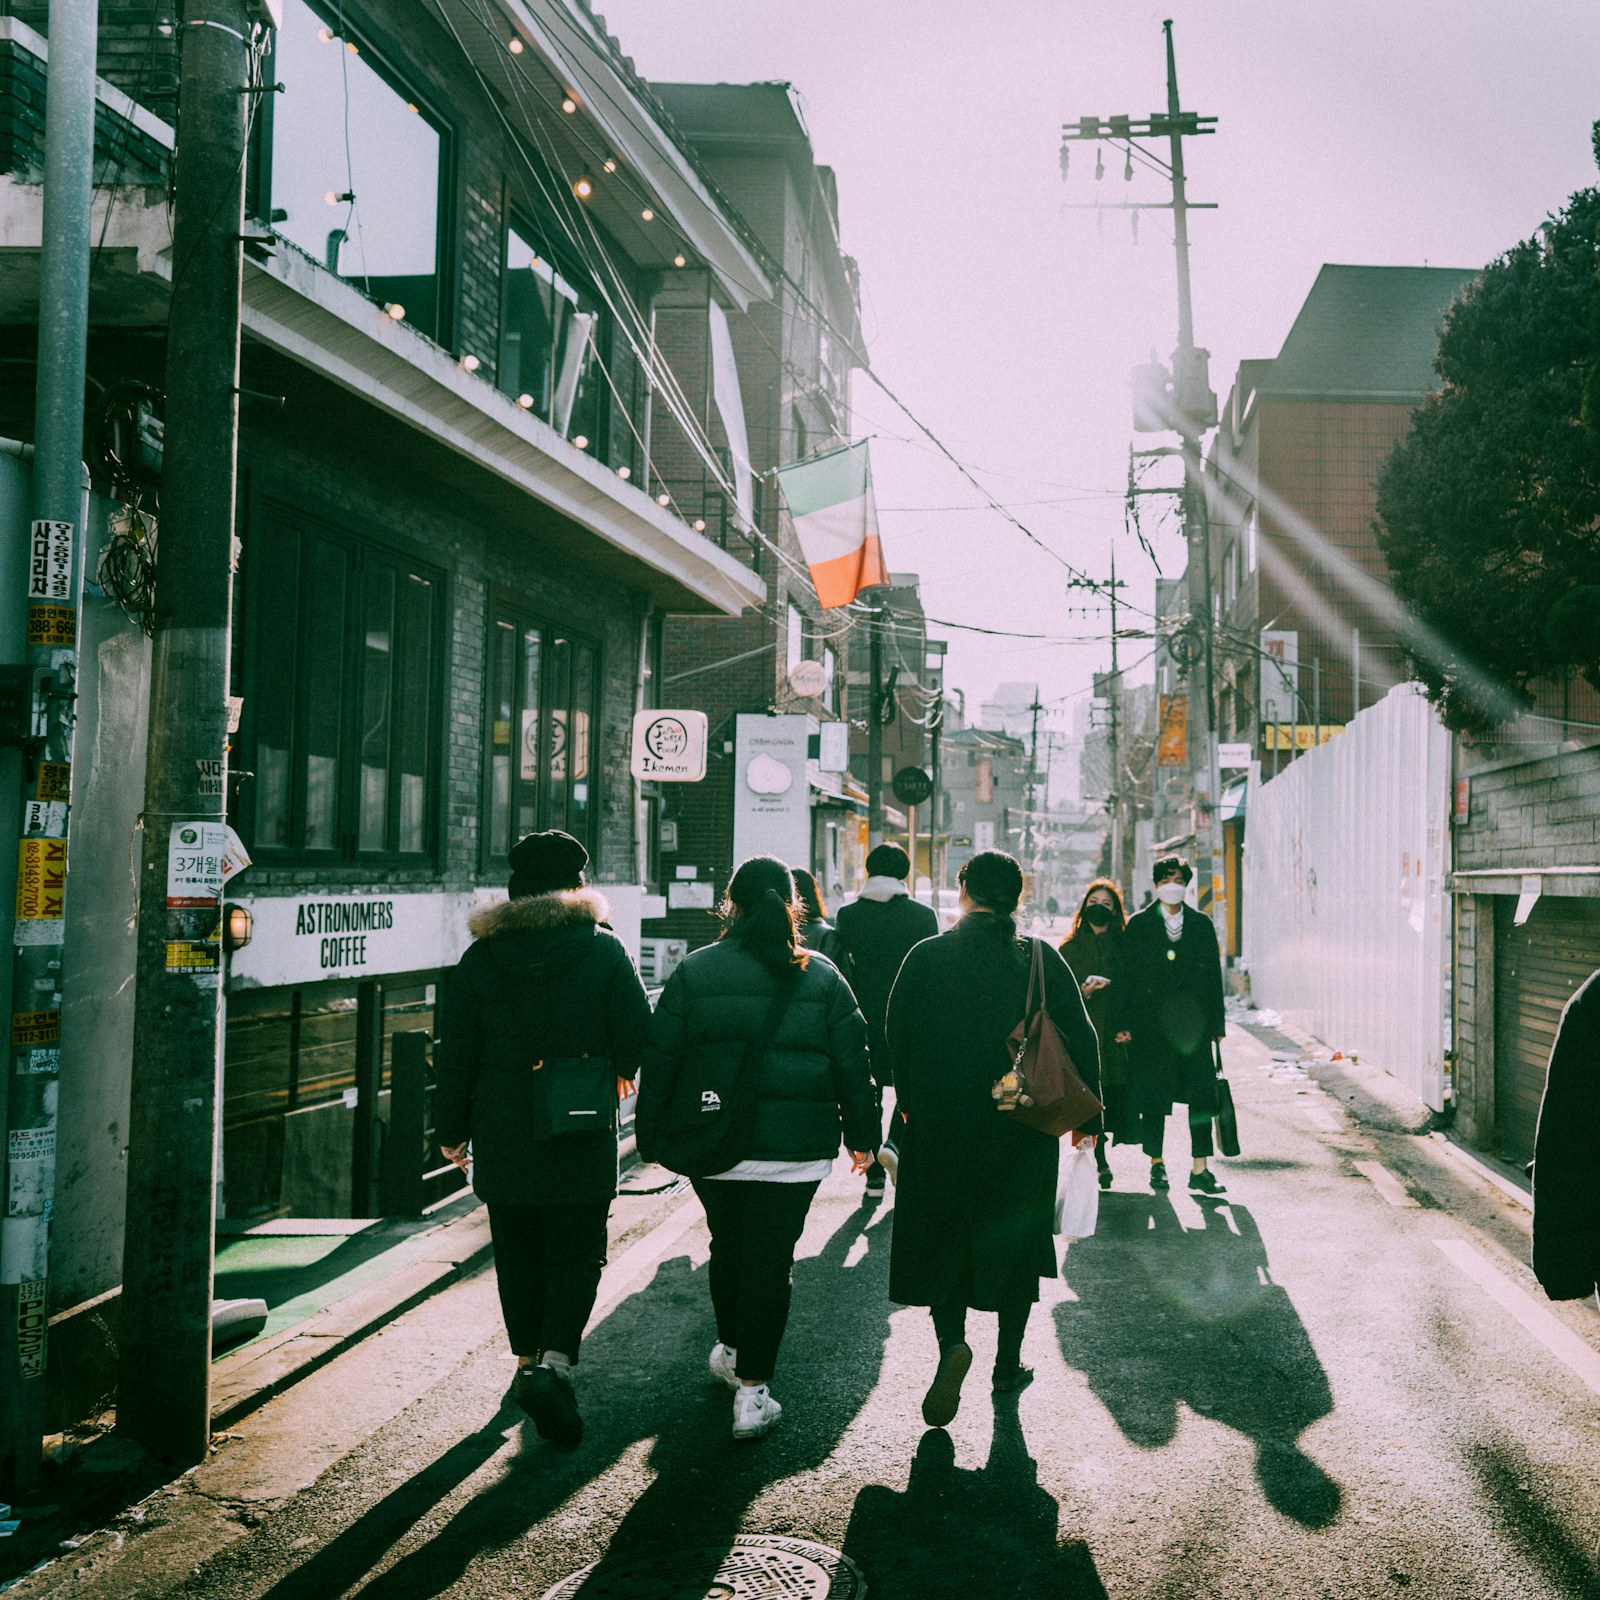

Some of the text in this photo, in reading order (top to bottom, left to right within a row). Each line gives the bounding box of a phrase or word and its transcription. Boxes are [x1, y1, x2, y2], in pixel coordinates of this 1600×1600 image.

[32, 522, 51, 595] 사다리차
[643, 758, 688, 773] Ikemen
[176, 856, 217, 875] 3개월
[296, 902, 394, 935] ASTRONOMERS
[321, 936, 367, 968] COFFEE
